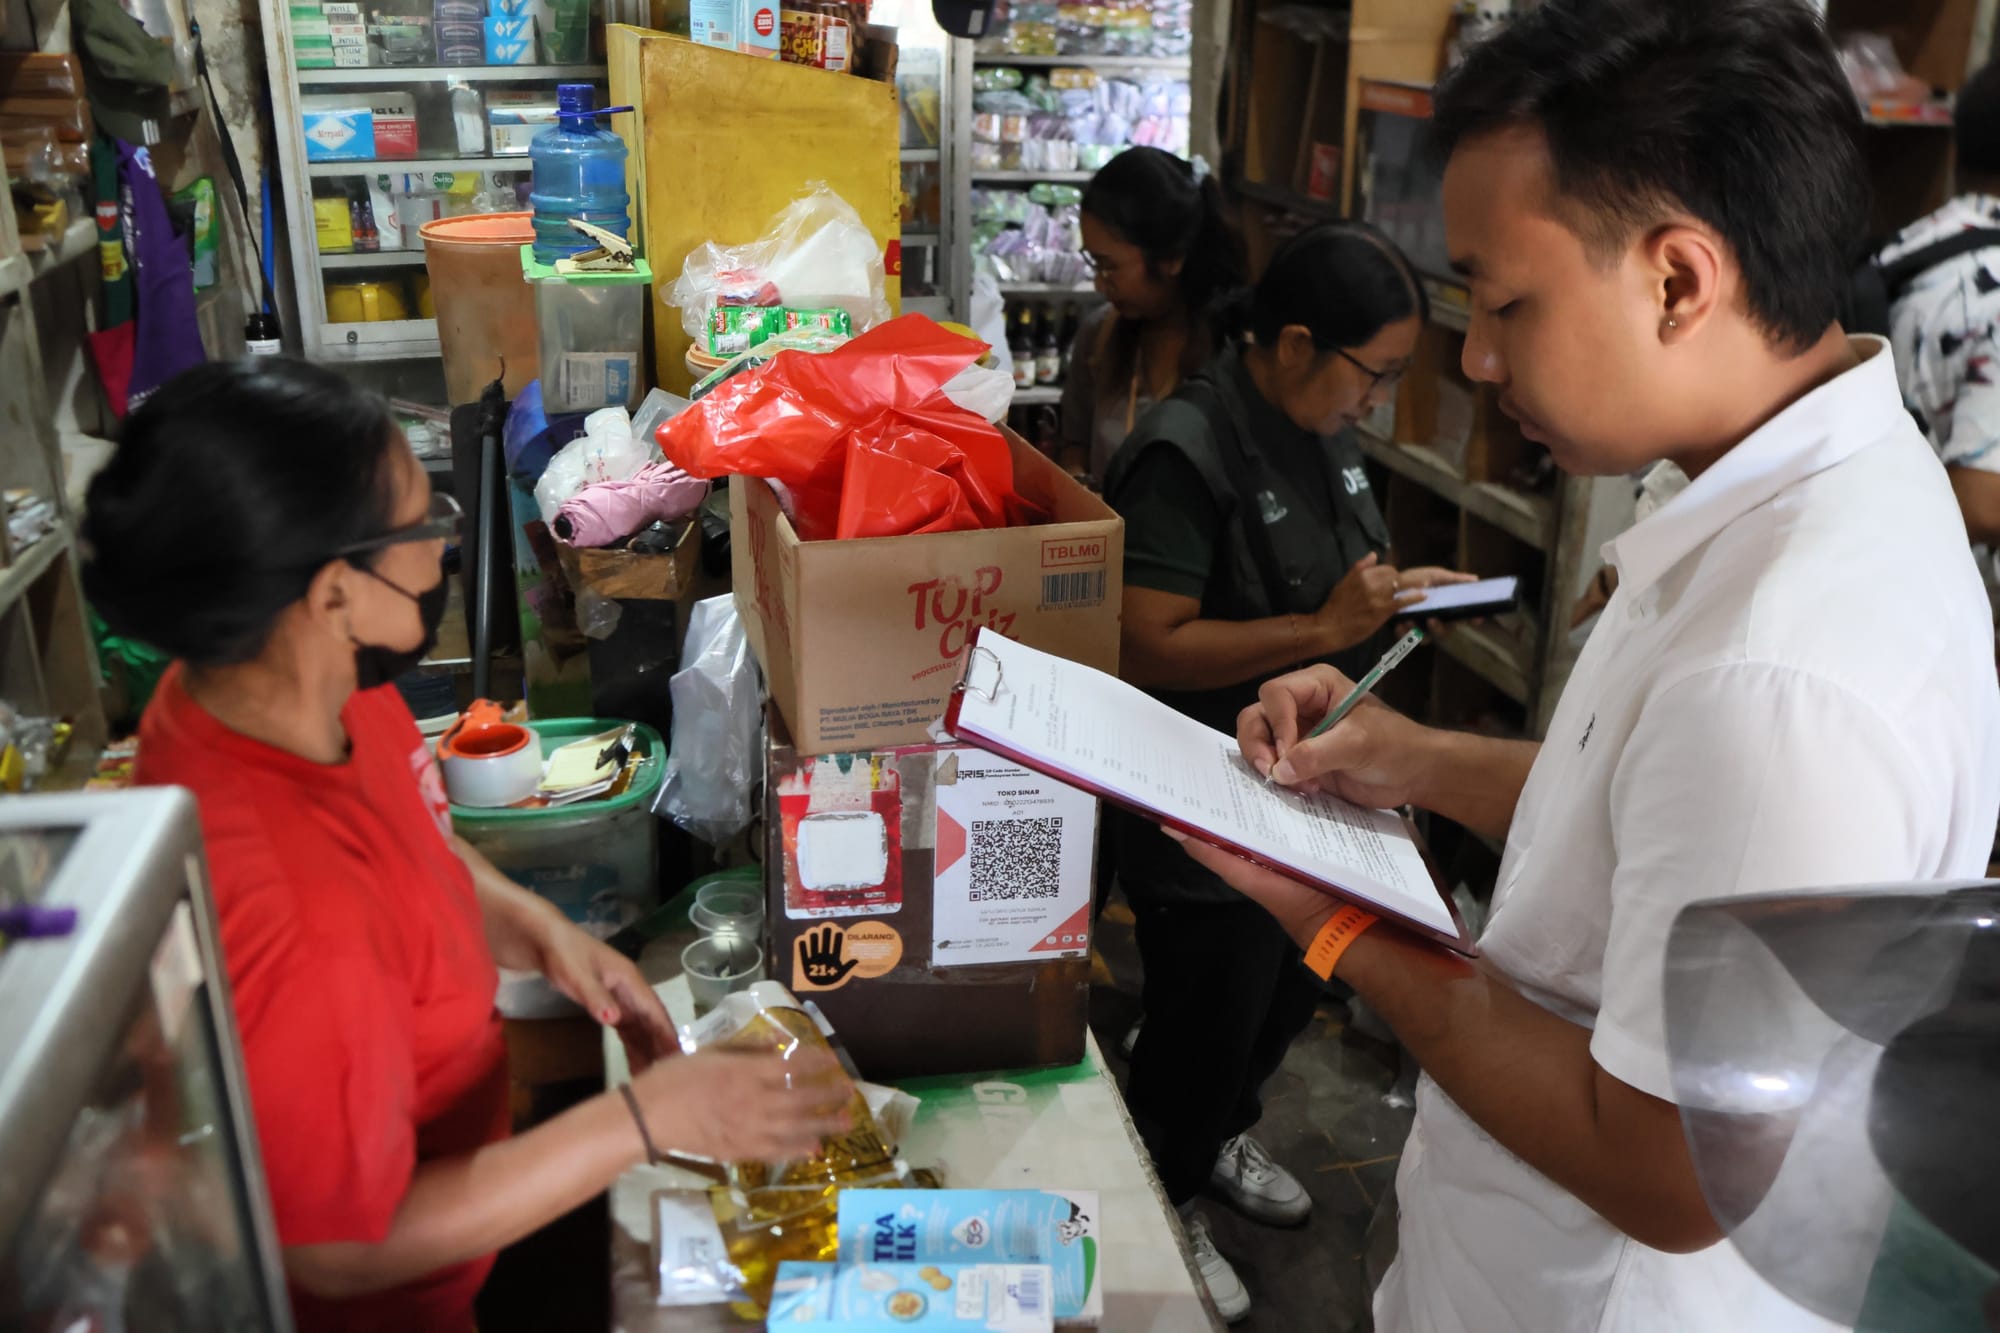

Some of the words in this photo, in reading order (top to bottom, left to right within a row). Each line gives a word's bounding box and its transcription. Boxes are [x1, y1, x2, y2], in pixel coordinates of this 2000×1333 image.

[907, 566, 1003, 631] TOP
[808, 964, 838, 977] 21+
[873, 1213, 895, 1262] TRA
[896, 1223, 917, 1261] ILK
